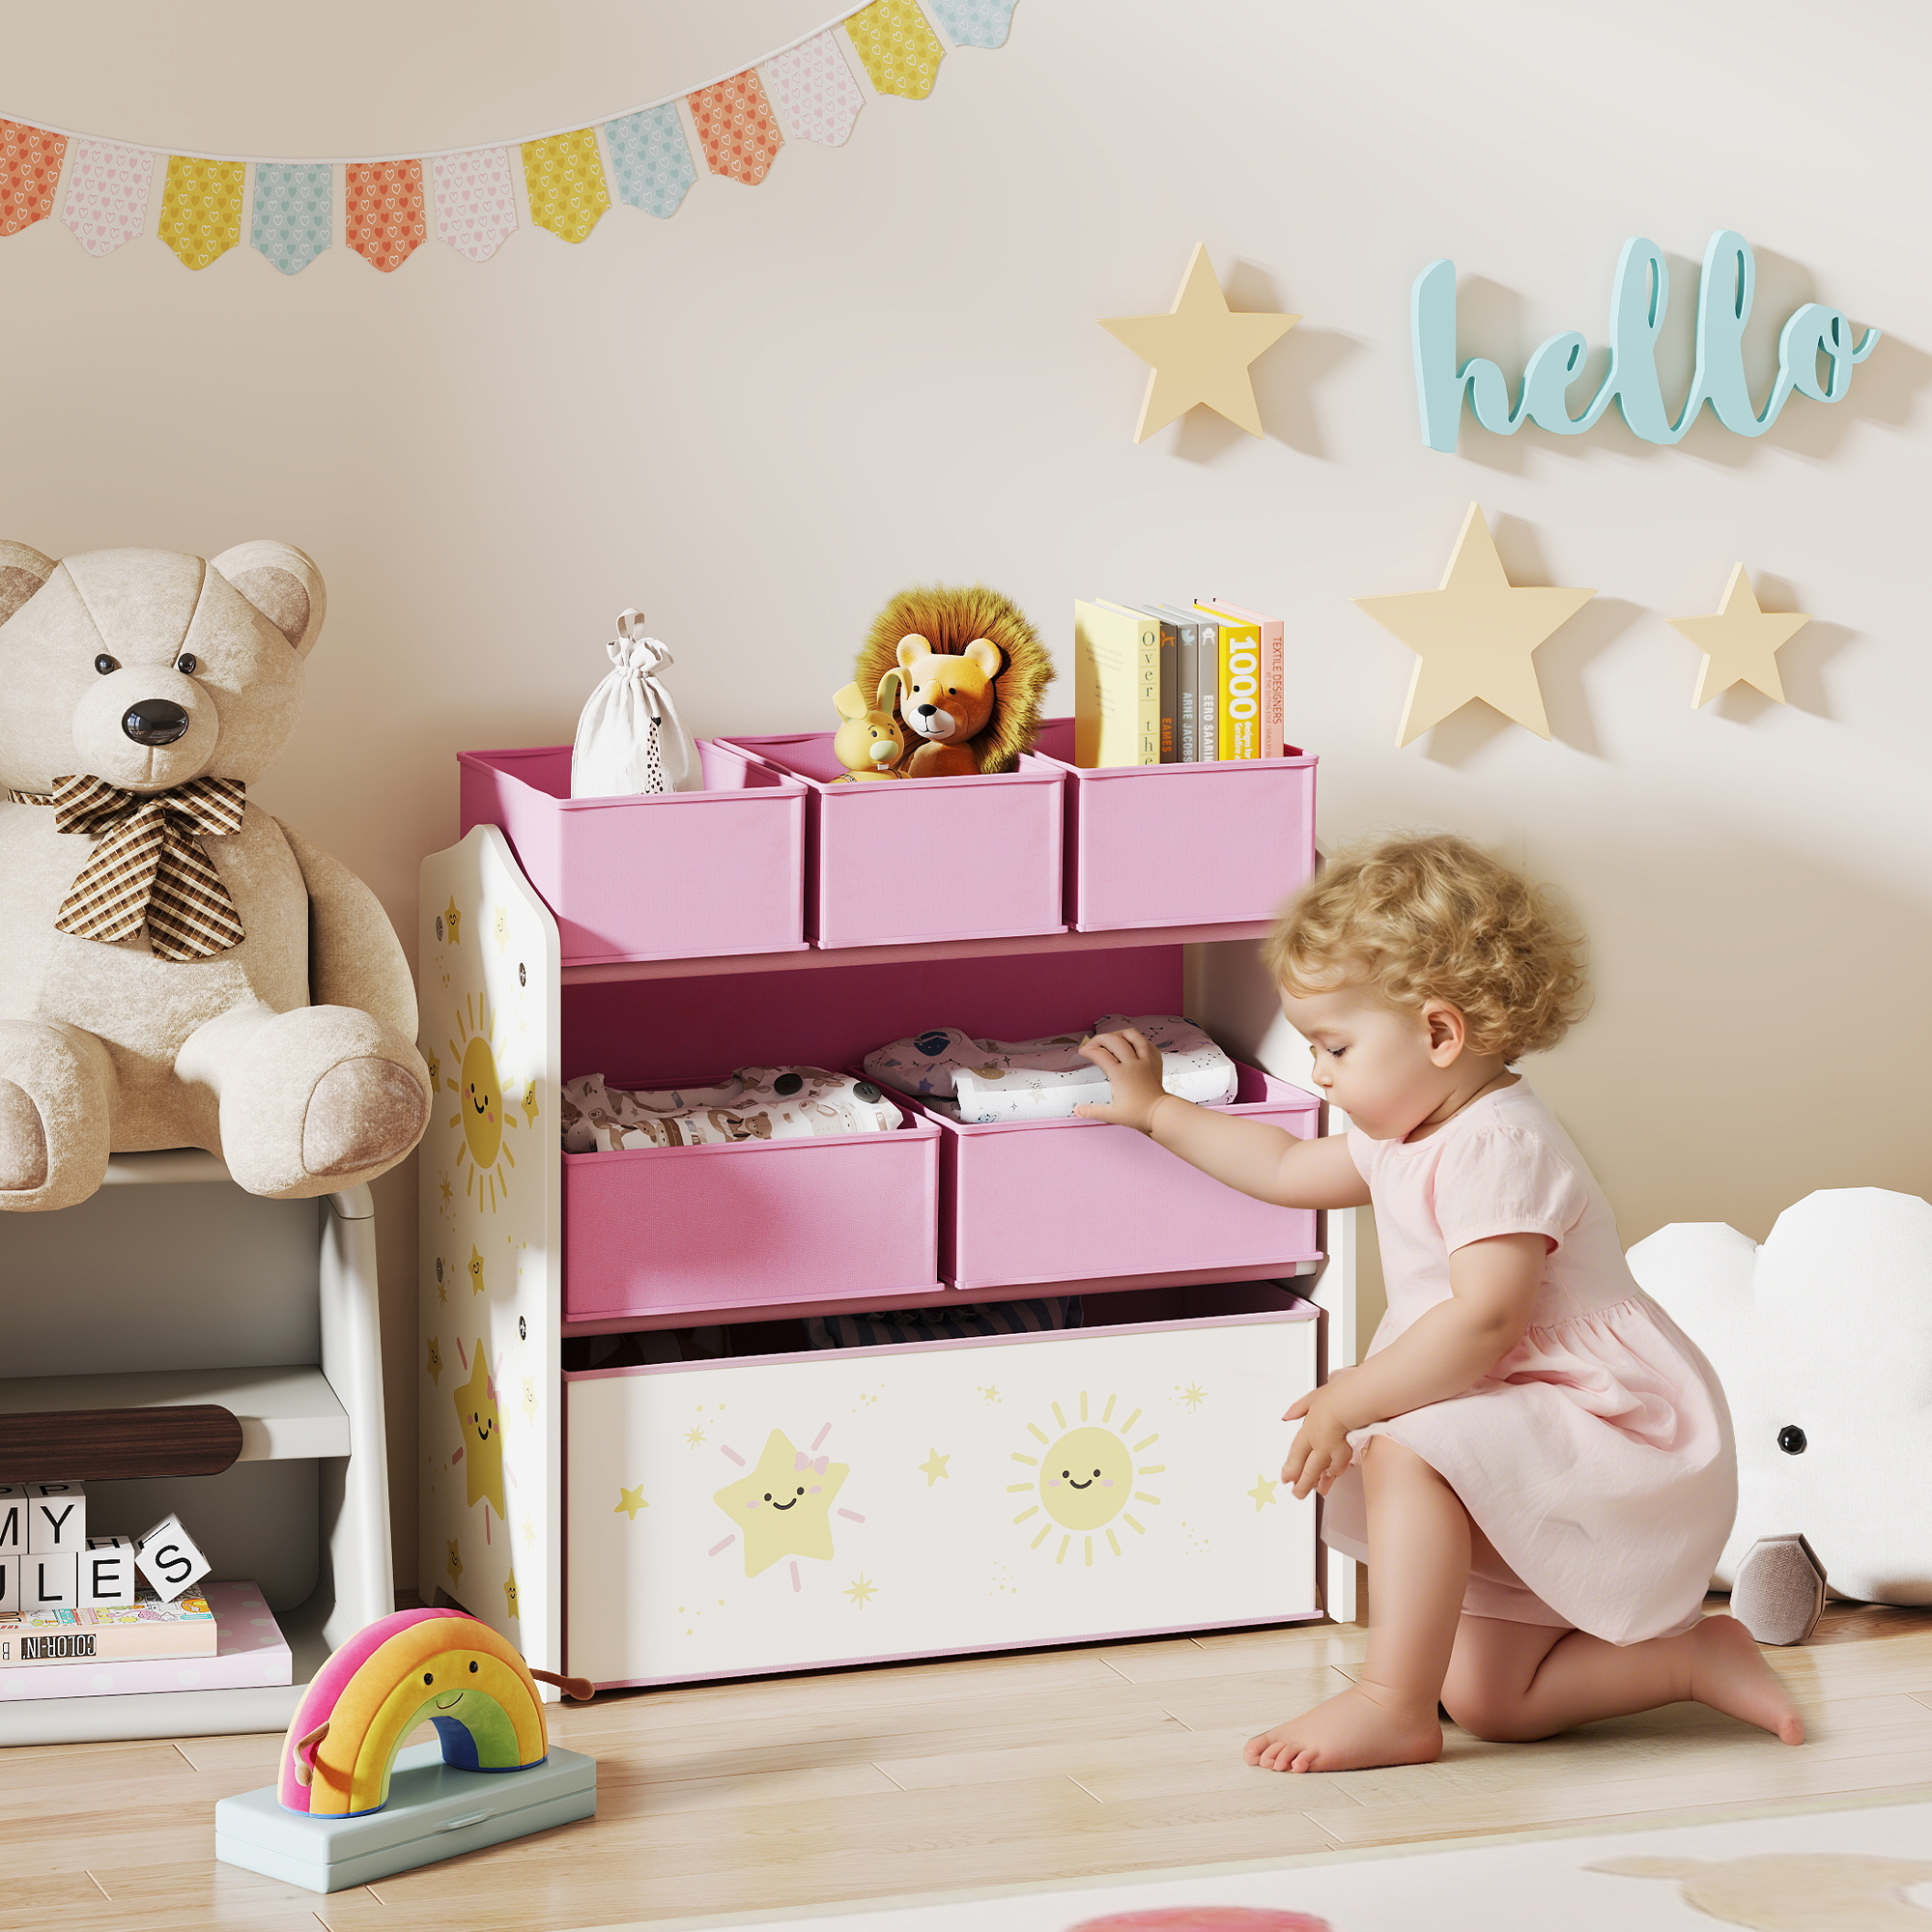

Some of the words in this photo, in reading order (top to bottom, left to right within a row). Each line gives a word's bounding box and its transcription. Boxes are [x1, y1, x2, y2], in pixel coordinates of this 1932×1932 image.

[1410, 230, 1882, 453] hello
[1142, 631, 1155, 697] Over
[1273, 637, 1282, 671] TEXTILE
[1229, 636, 1258, 720] 1000
[1273, 674, 1282, 724] DESIGNERS
[1182, 693, 1193, 720] ARNE
[1204, 695, 1213, 722] EERO
[1162, 718, 1172, 753] EAMES
